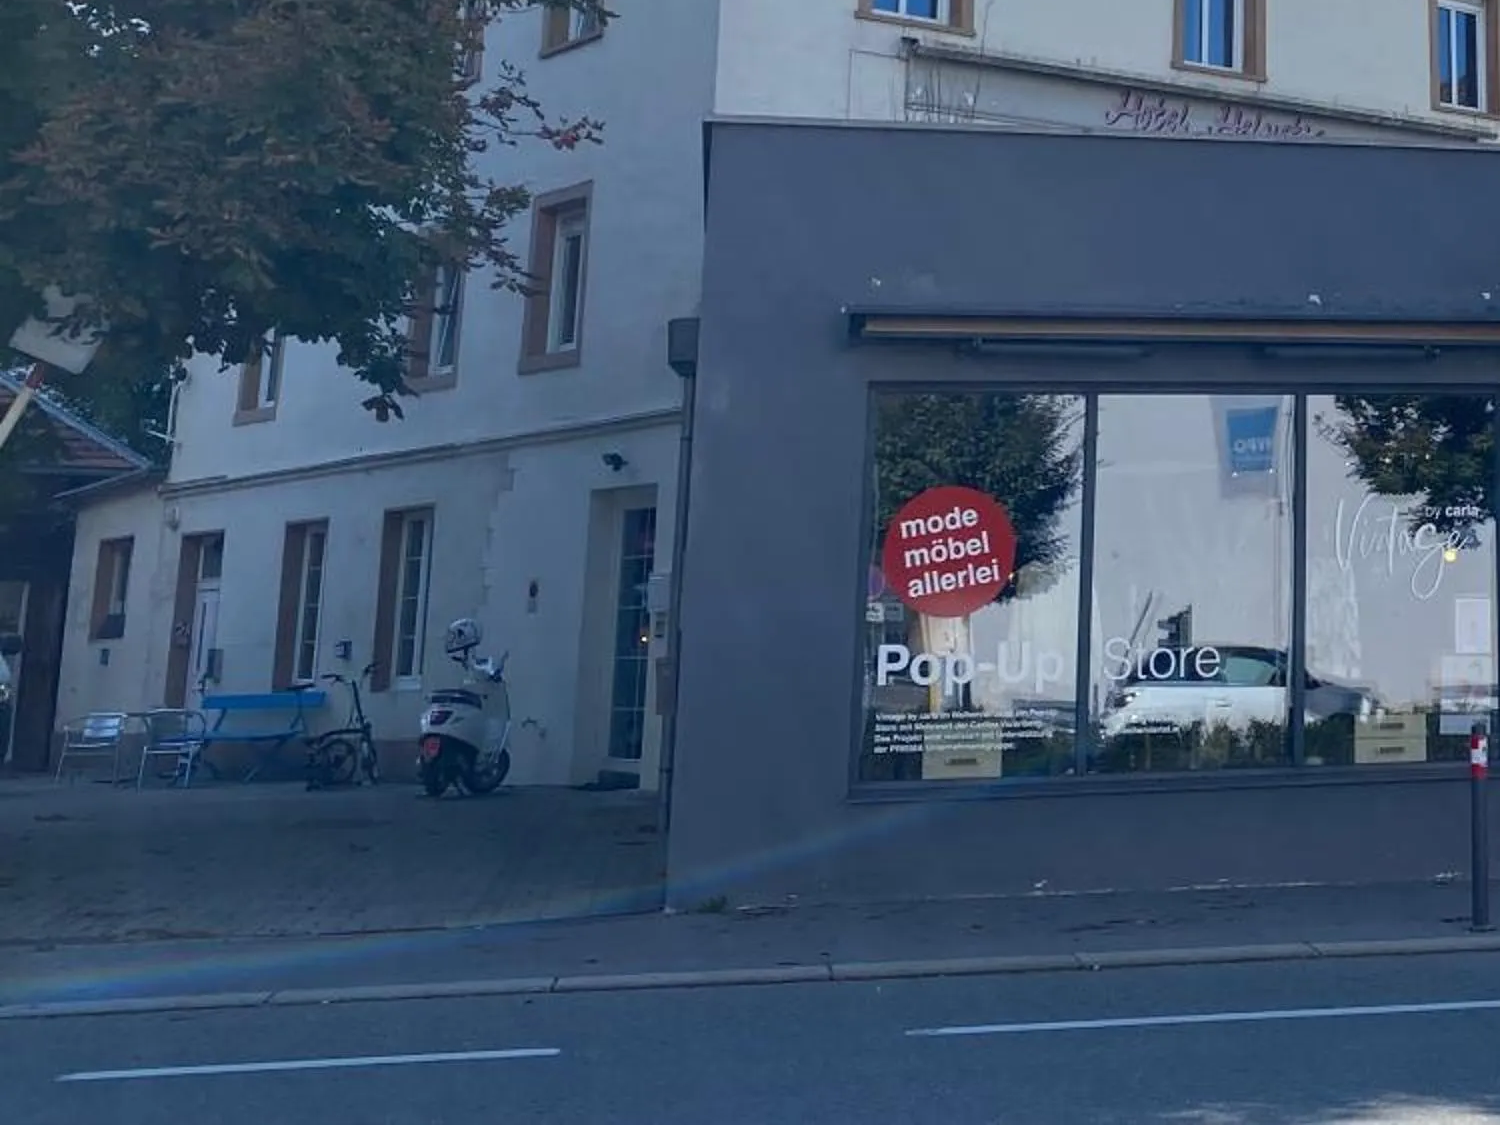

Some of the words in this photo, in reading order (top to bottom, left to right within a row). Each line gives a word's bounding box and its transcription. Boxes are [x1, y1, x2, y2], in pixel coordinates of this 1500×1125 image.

[901, 507, 978, 539] mode
[1425, 506, 1441, 519] by
[1445, 505, 1480, 517] carla
[904, 531, 990, 568] möbel
[908, 559, 1000, 598] allerlei
[877, 639, 1066, 696] Pop-Up
[1103, 637, 1222, 681] Store
